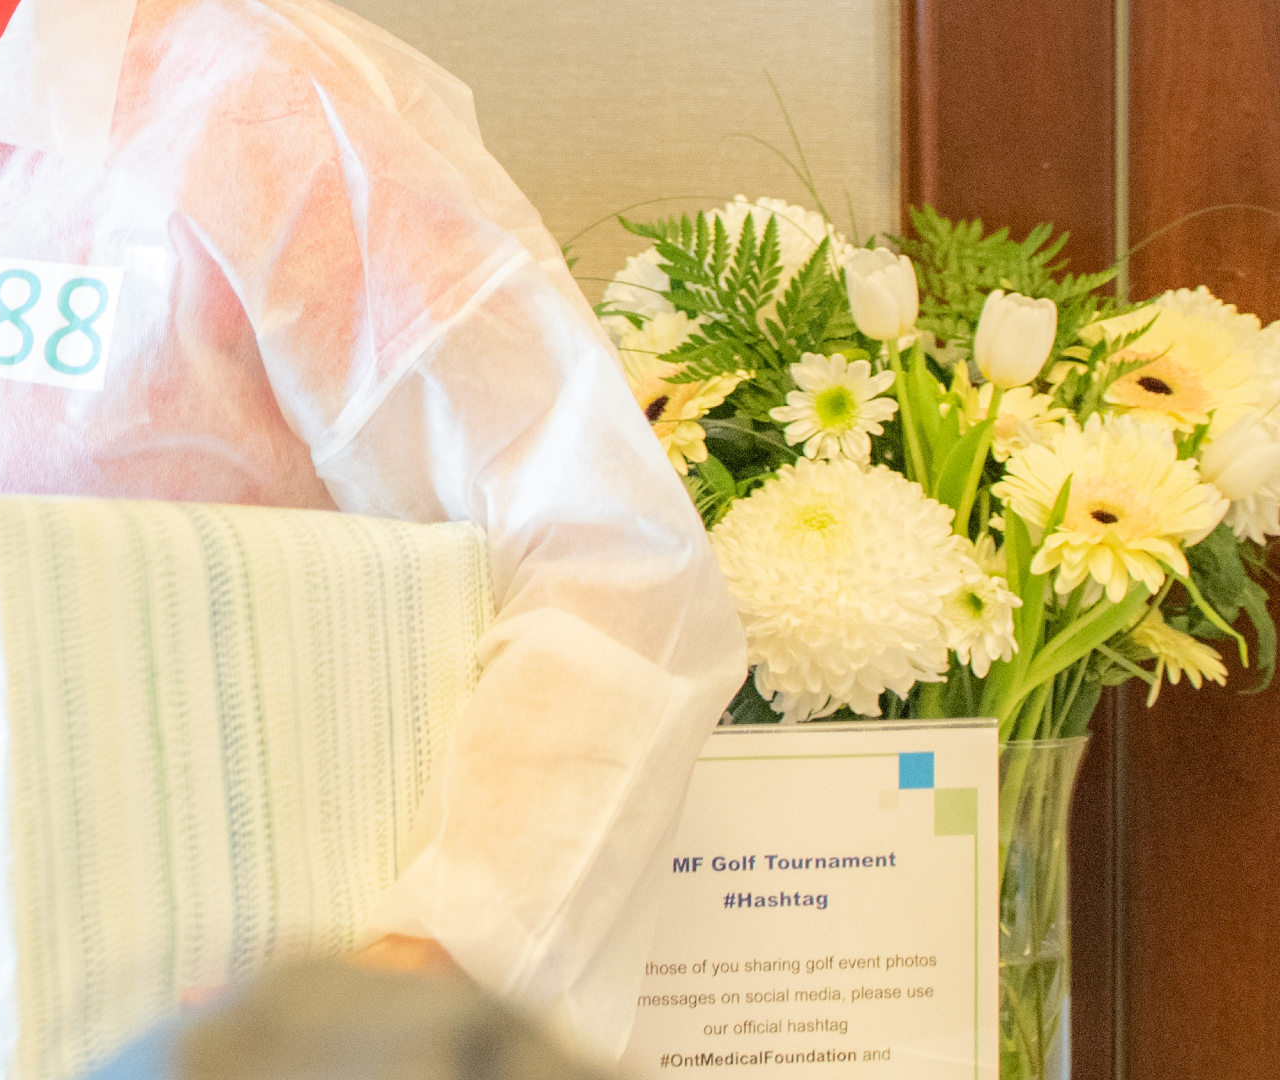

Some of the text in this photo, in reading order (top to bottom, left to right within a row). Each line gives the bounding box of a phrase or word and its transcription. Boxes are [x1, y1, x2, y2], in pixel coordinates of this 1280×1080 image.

[711, 855, 756, 872] Golf
[764, 852, 896, 871] Tournament
[723, 891, 828, 910] #Hashtag
[645, 954, 938, 977] those of you sharing golf event photos
[637, 986, 934, 1009] messages on social media, please use
[702, 1018, 849, 1036] our official hashtag
[660, 1048, 891, 1068] #OntMedicalFoundation and
